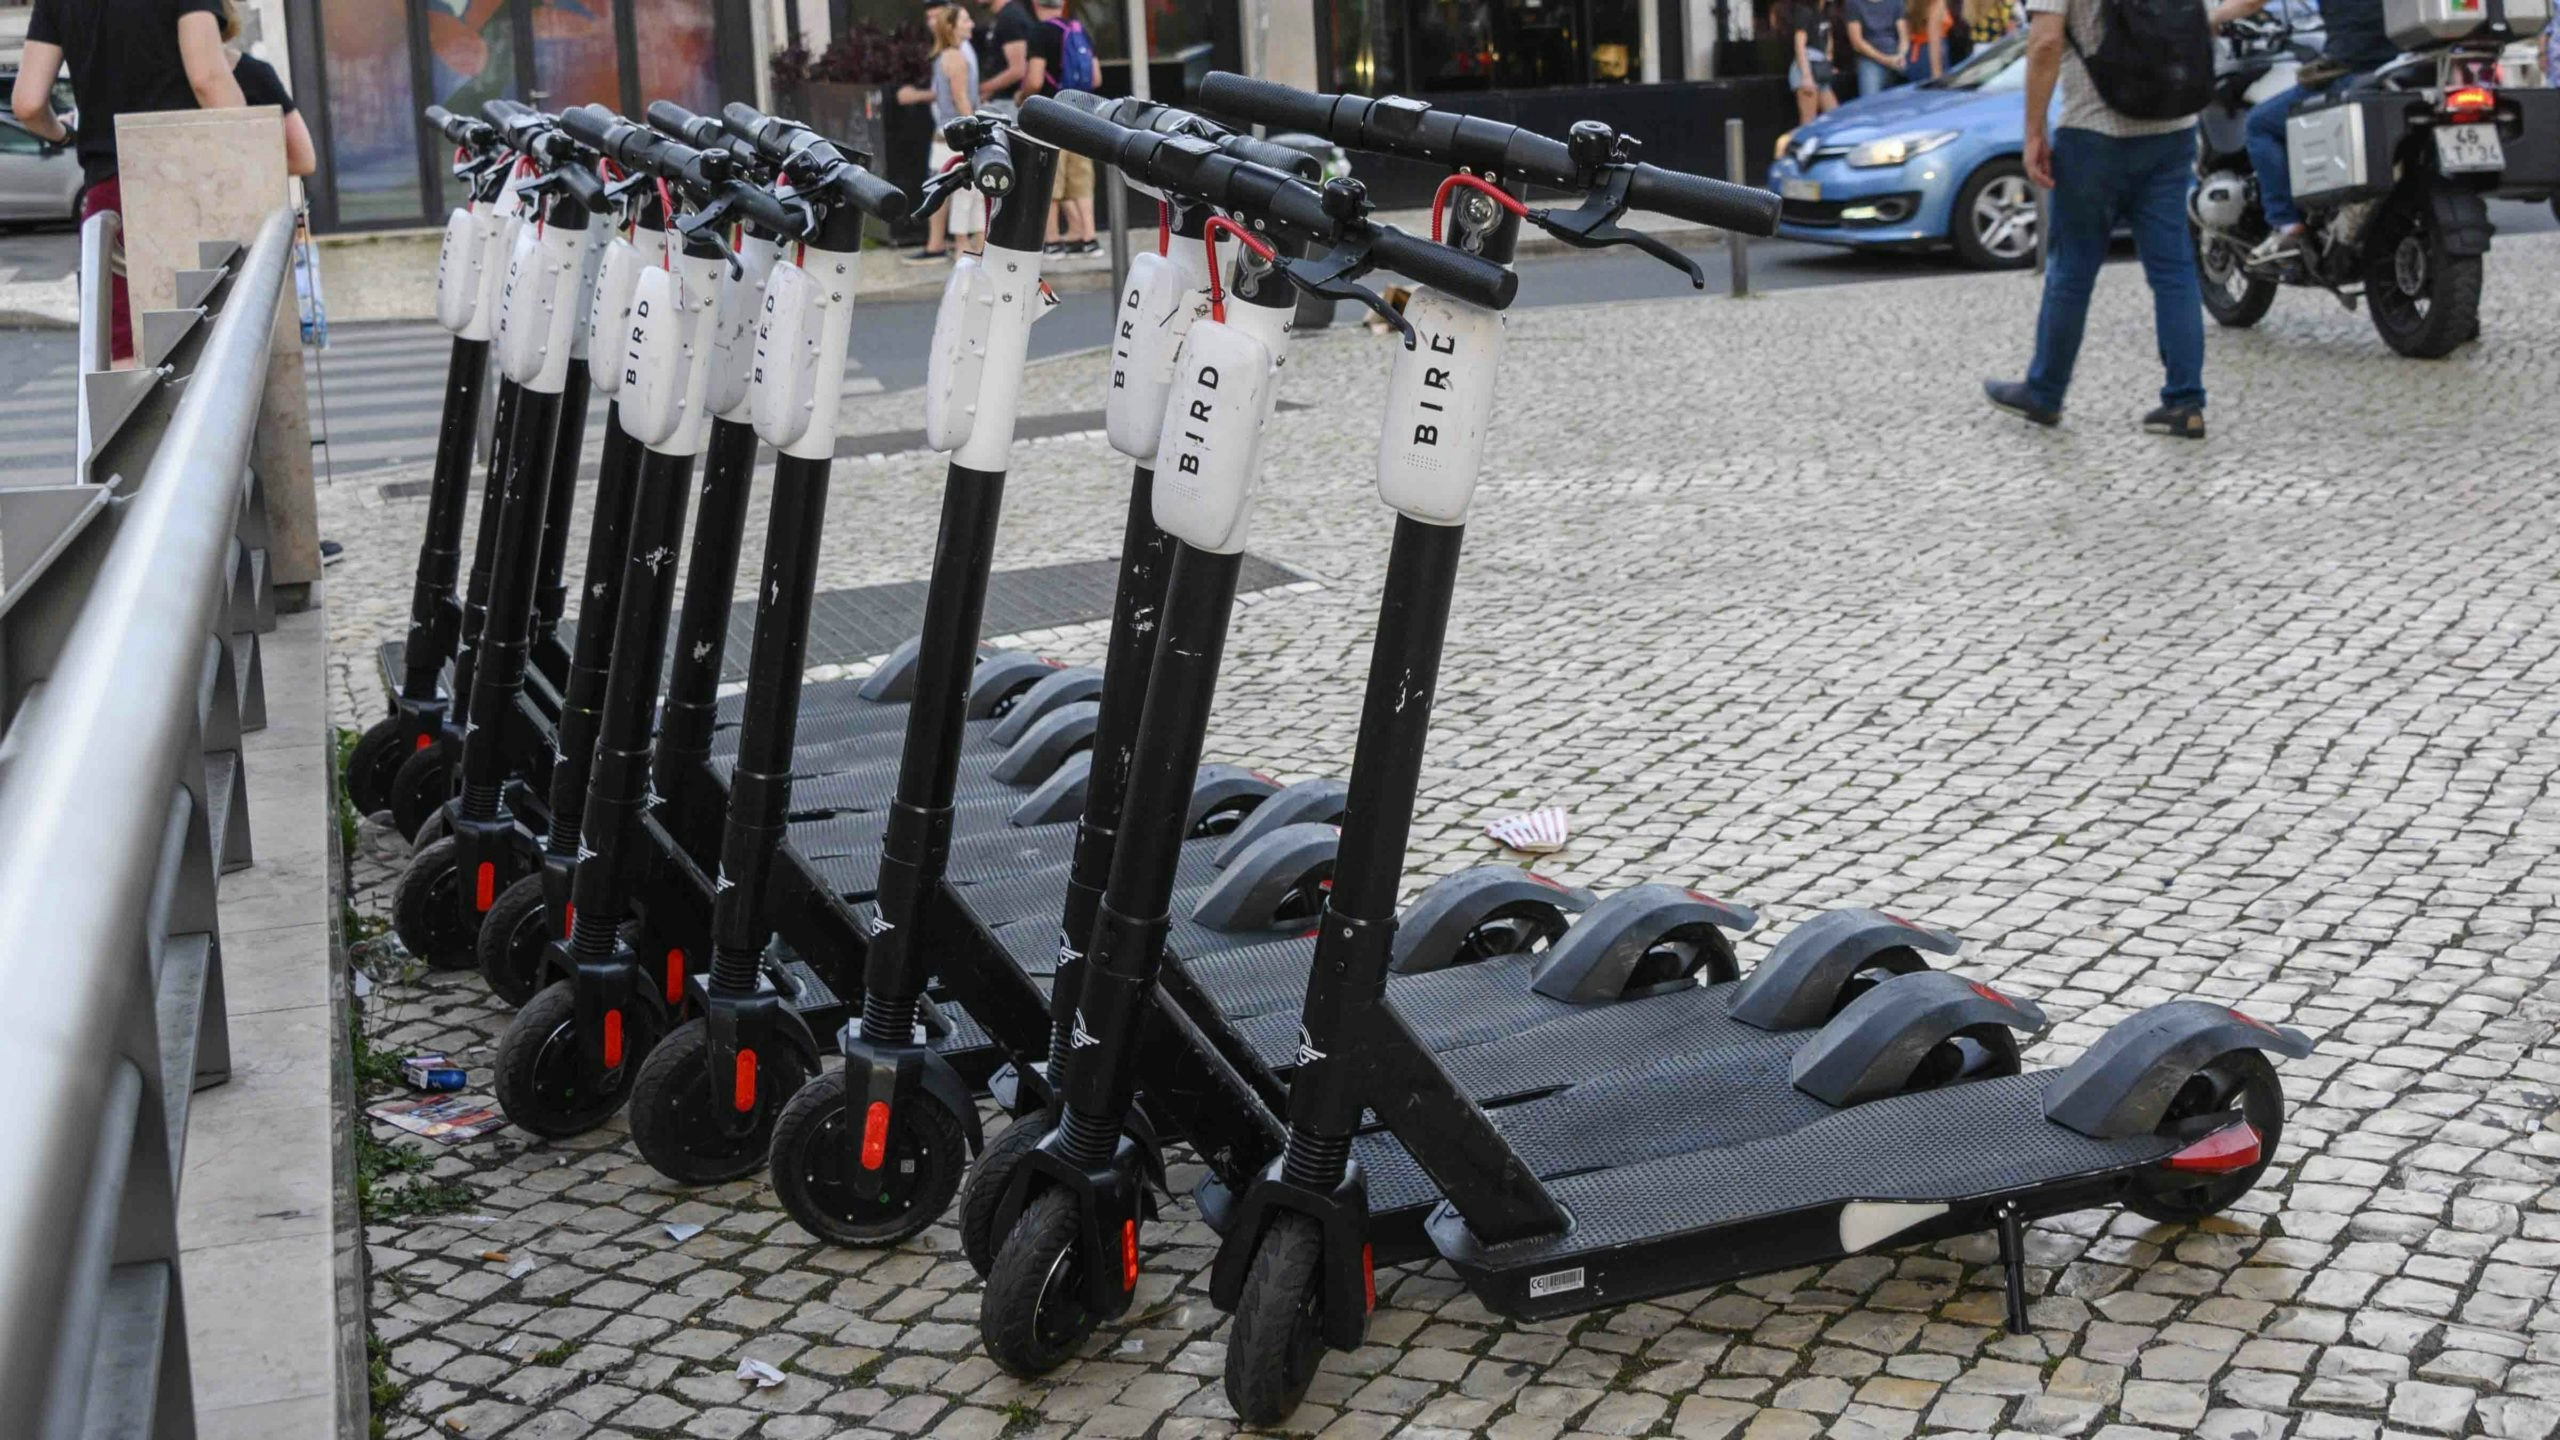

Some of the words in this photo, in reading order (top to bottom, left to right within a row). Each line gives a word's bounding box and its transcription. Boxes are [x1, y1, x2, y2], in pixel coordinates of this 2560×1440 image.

[500, 261, 518, 333] BIRD
[590, 264, 608, 338] BIRD
[754, 295, 775, 384] BIRD
[1113, 289, 1141, 389] BIRD
[625, 300, 650, 386] BIRD
[1178, 366, 1219, 476] BIRD
[1531, 1278, 1544, 1290] CE
